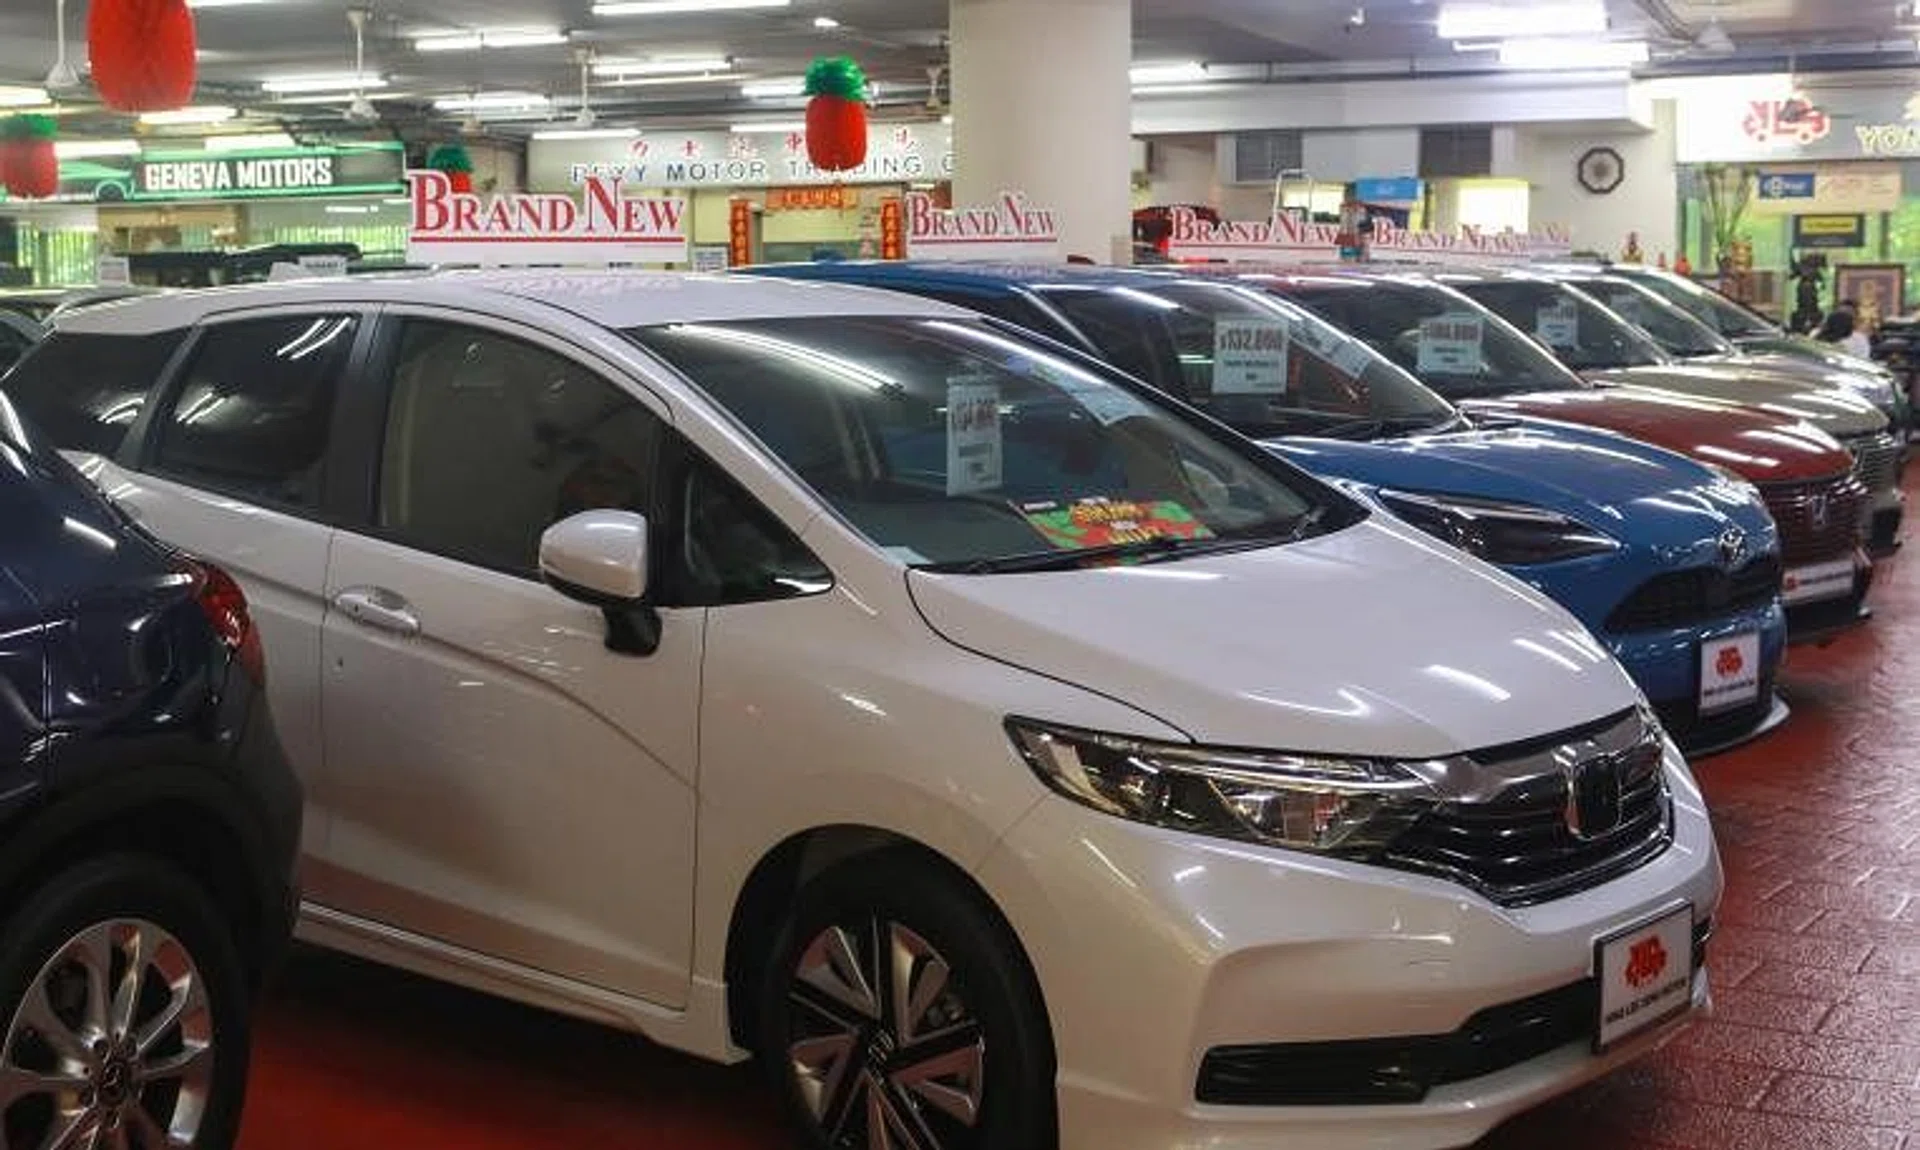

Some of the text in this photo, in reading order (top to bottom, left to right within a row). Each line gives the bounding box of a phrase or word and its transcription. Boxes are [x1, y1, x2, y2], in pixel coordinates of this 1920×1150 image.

[145, 157, 333, 191] GENEVA MOTORS
[667, 160, 766, 182] MOTOR
[411, 173, 684, 232] BRAND NEW
[911, 195, 998, 235] BRAND
[1003, 194, 1054, 235] NEW
[1173, 207, 1339, 244] BRAND NEW
[1374, 218, 1456, 250] BRAND
